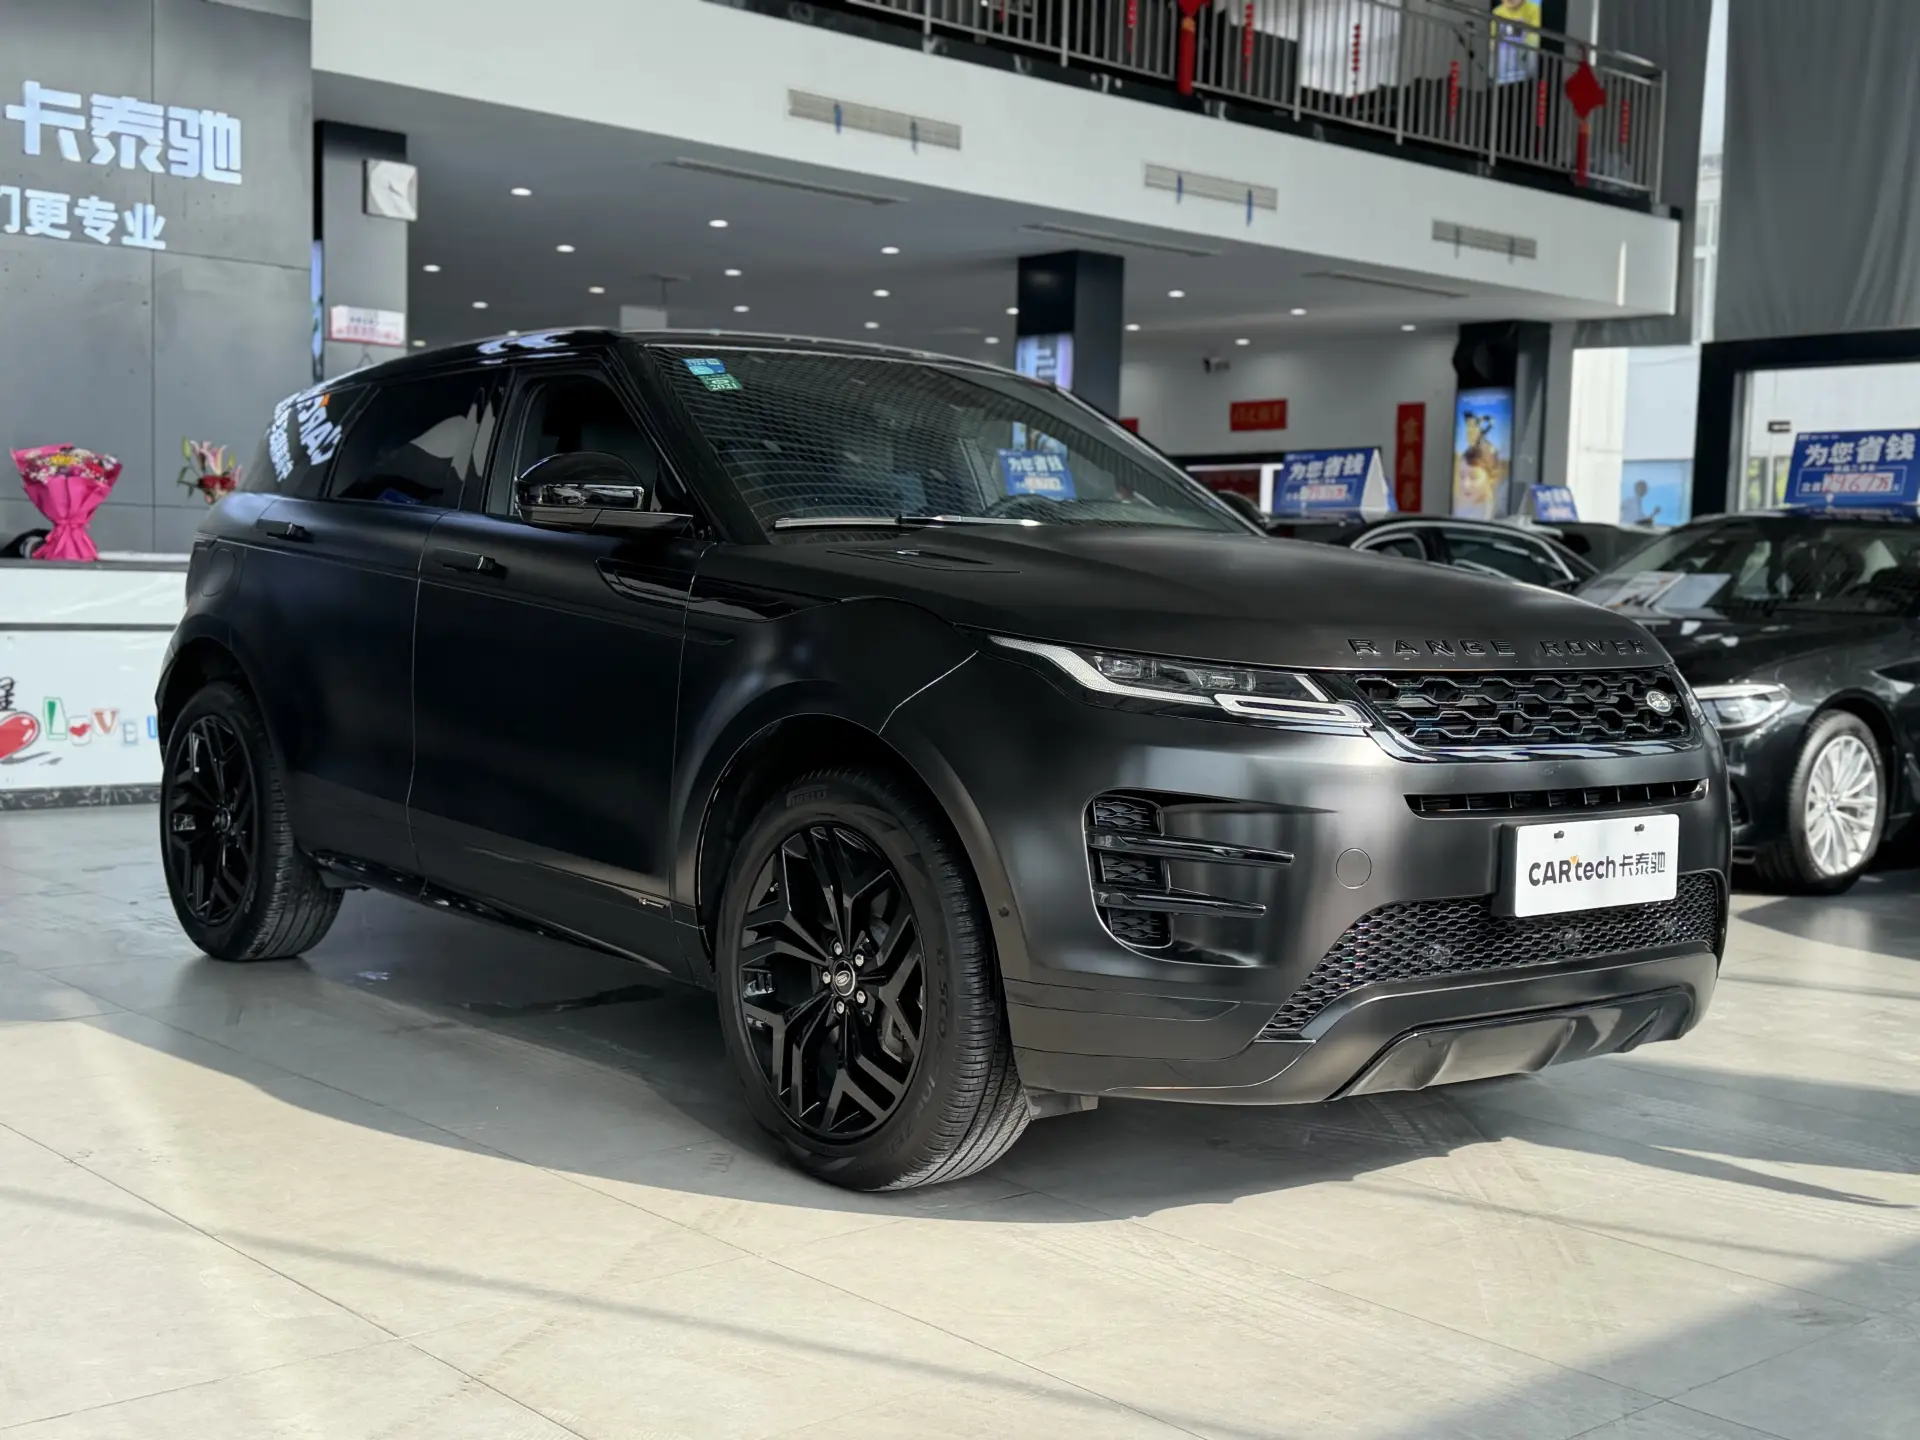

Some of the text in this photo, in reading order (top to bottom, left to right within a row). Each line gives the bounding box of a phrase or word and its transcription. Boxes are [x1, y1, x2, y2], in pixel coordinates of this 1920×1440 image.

[5, 80, 242, 185] 卡泰驰
[1803, 433, 1916, 467] 为您省钱
[1347, 638, 1648, 657] RANGE ROVER
[1528, 851, 1666, 887] CARtech 卡泰驰
